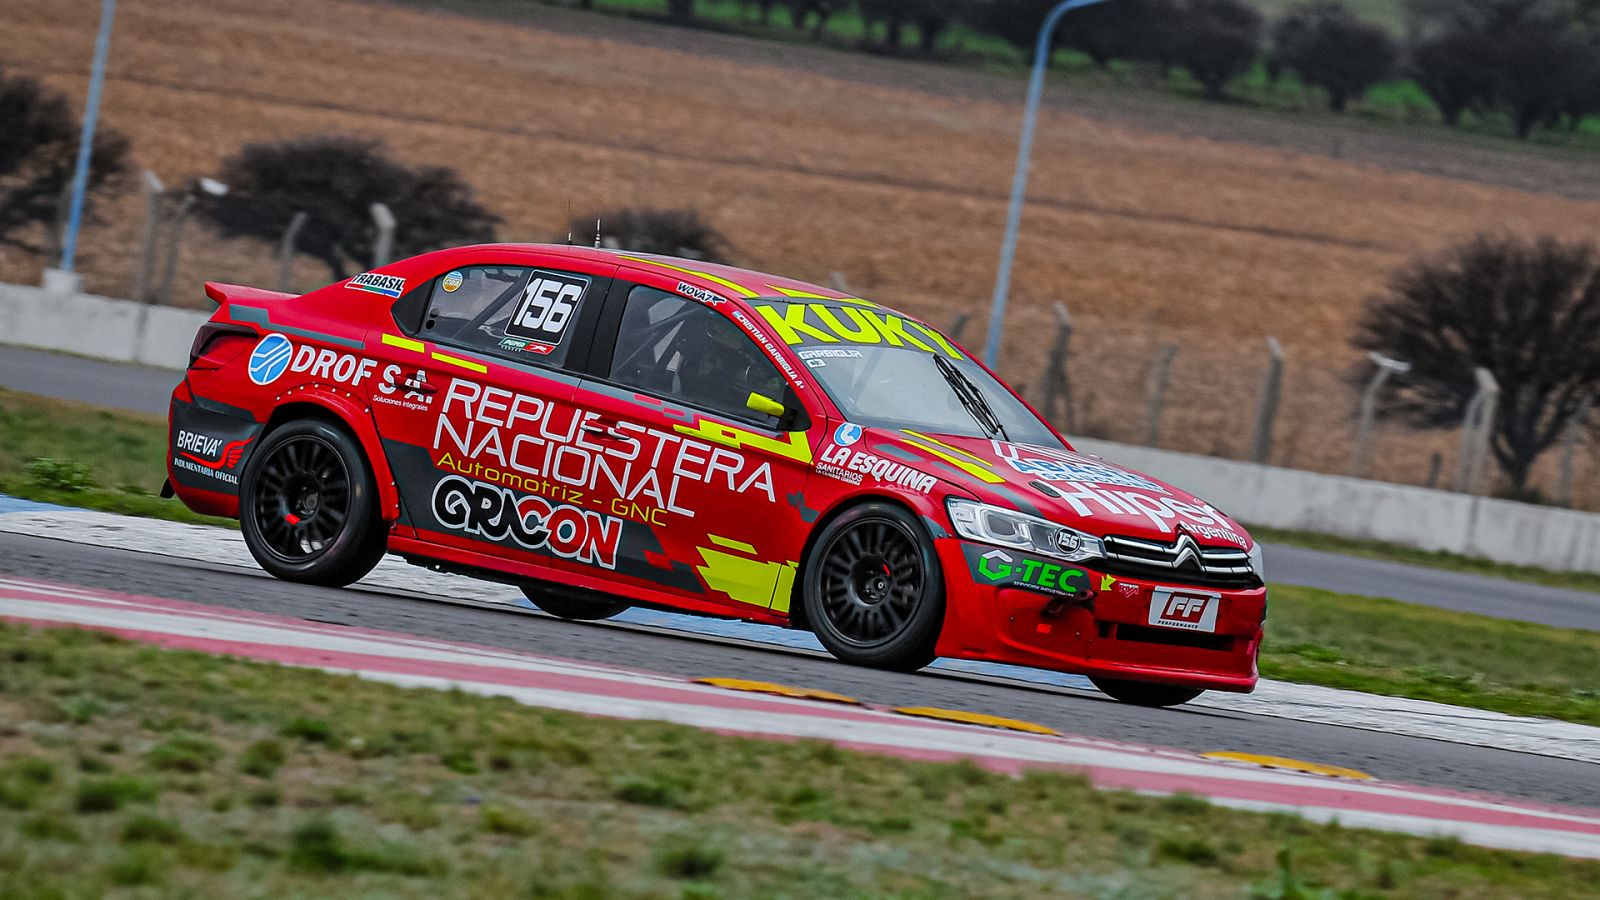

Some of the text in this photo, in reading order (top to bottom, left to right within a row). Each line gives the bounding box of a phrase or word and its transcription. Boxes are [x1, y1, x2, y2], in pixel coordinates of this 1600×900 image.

[351, 274, 405, 292] TRABASIL
[513, 276, 582, 333] 156
[737, 314, 769, 344] CRISTIAN
[764, 342, 798, 380] GARBIGLIA
[755, 304, 963, 360] KUKY
[290, 344, 377, 386] DROF
[798, 349, 863, 360] GARBIGLIA
[806, 358, 826, 369] C3
[372, 394, 428, 411] Soluciones integrales
[441, 377, 776, 503] REPUESTERA
[174, 457, 239, 485] INDUMENTARIA OFICIAL
[432, 413, 696, 518] NACIONAL
[816, 461, 863, 482] SANITARIOS
[820, 443, 938, 495] LA ESQUINA
[437, 452, 583, 506] Automotriz
[610, 499, 669, 527] GNC
[1035, 478, 1234, 534] Hiper
[431, 474, 623, 570] GRACON
[1058, 531, 1079, 549] 156
[1180, 520, 1248, 550] Argentina
[1166, 595, 1205, 618] FF
[1157, 620, 1199, 630] PERFORMANCE
